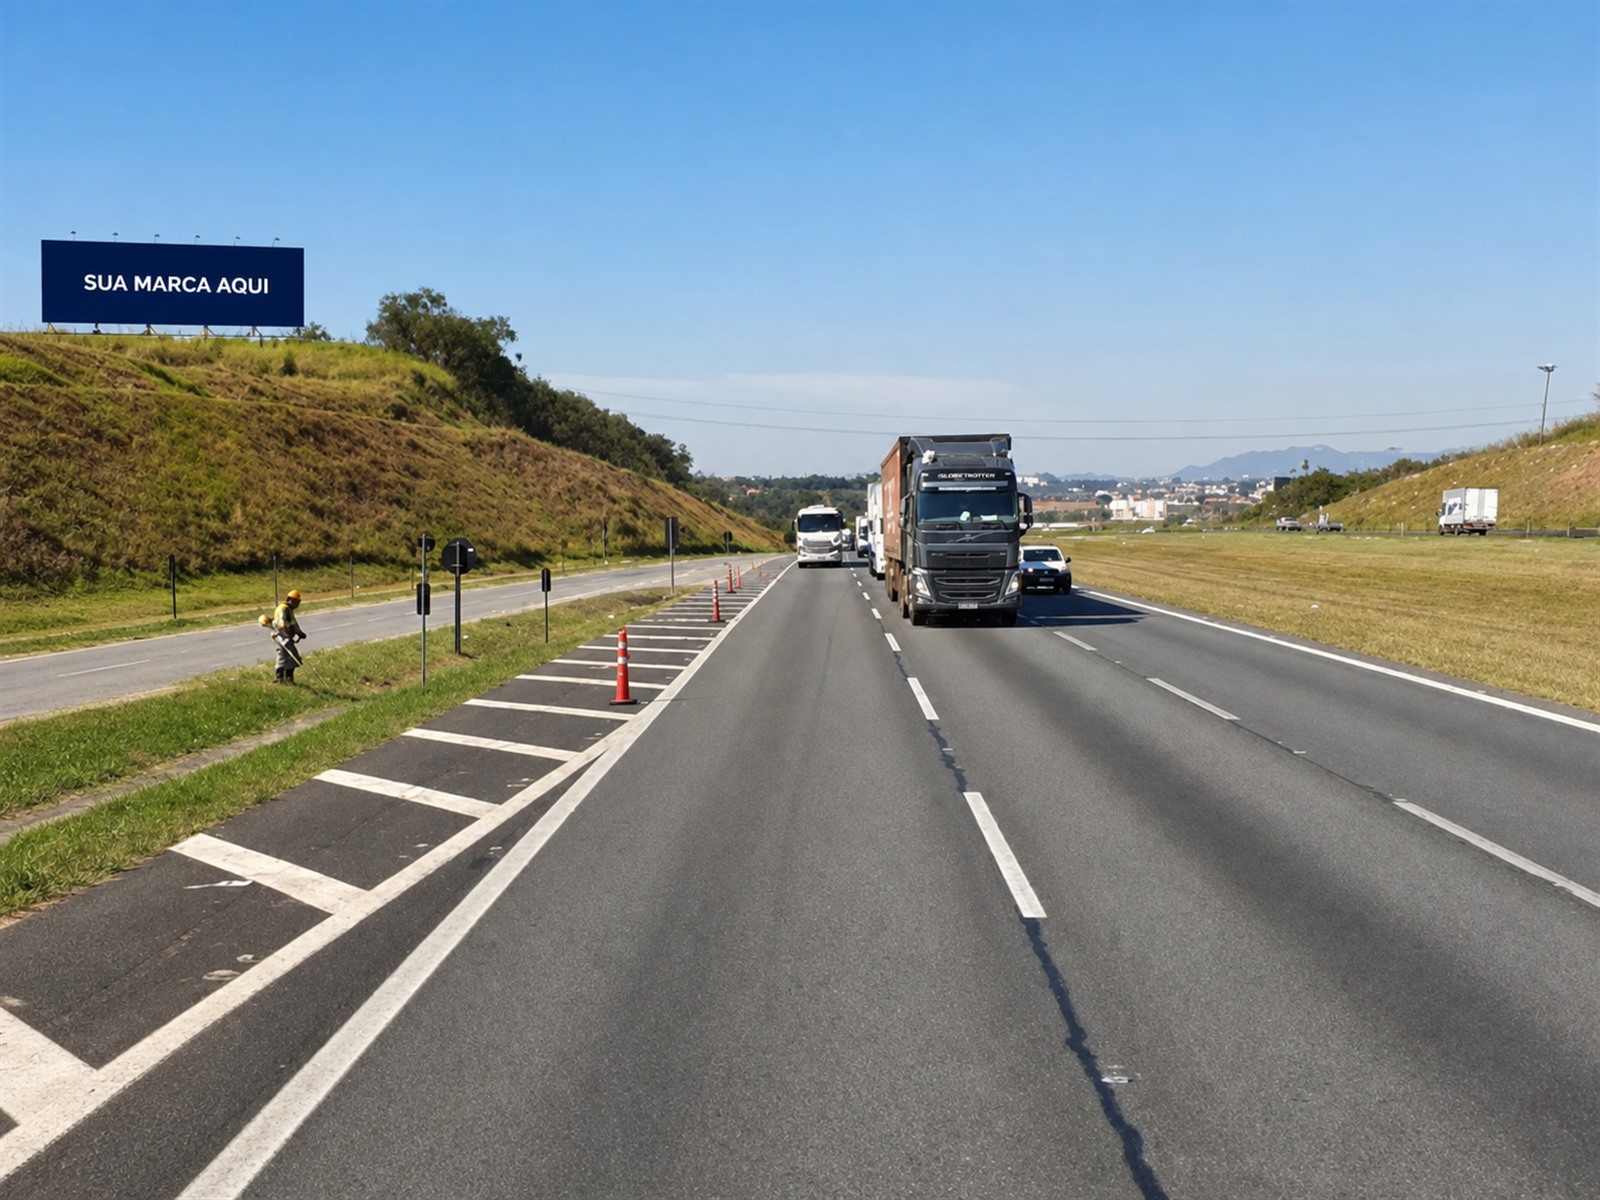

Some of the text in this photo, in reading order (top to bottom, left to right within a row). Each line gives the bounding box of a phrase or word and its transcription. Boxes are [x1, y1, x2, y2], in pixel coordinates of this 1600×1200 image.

[84, 273, 270, 296] SUA MARCA AQUI
